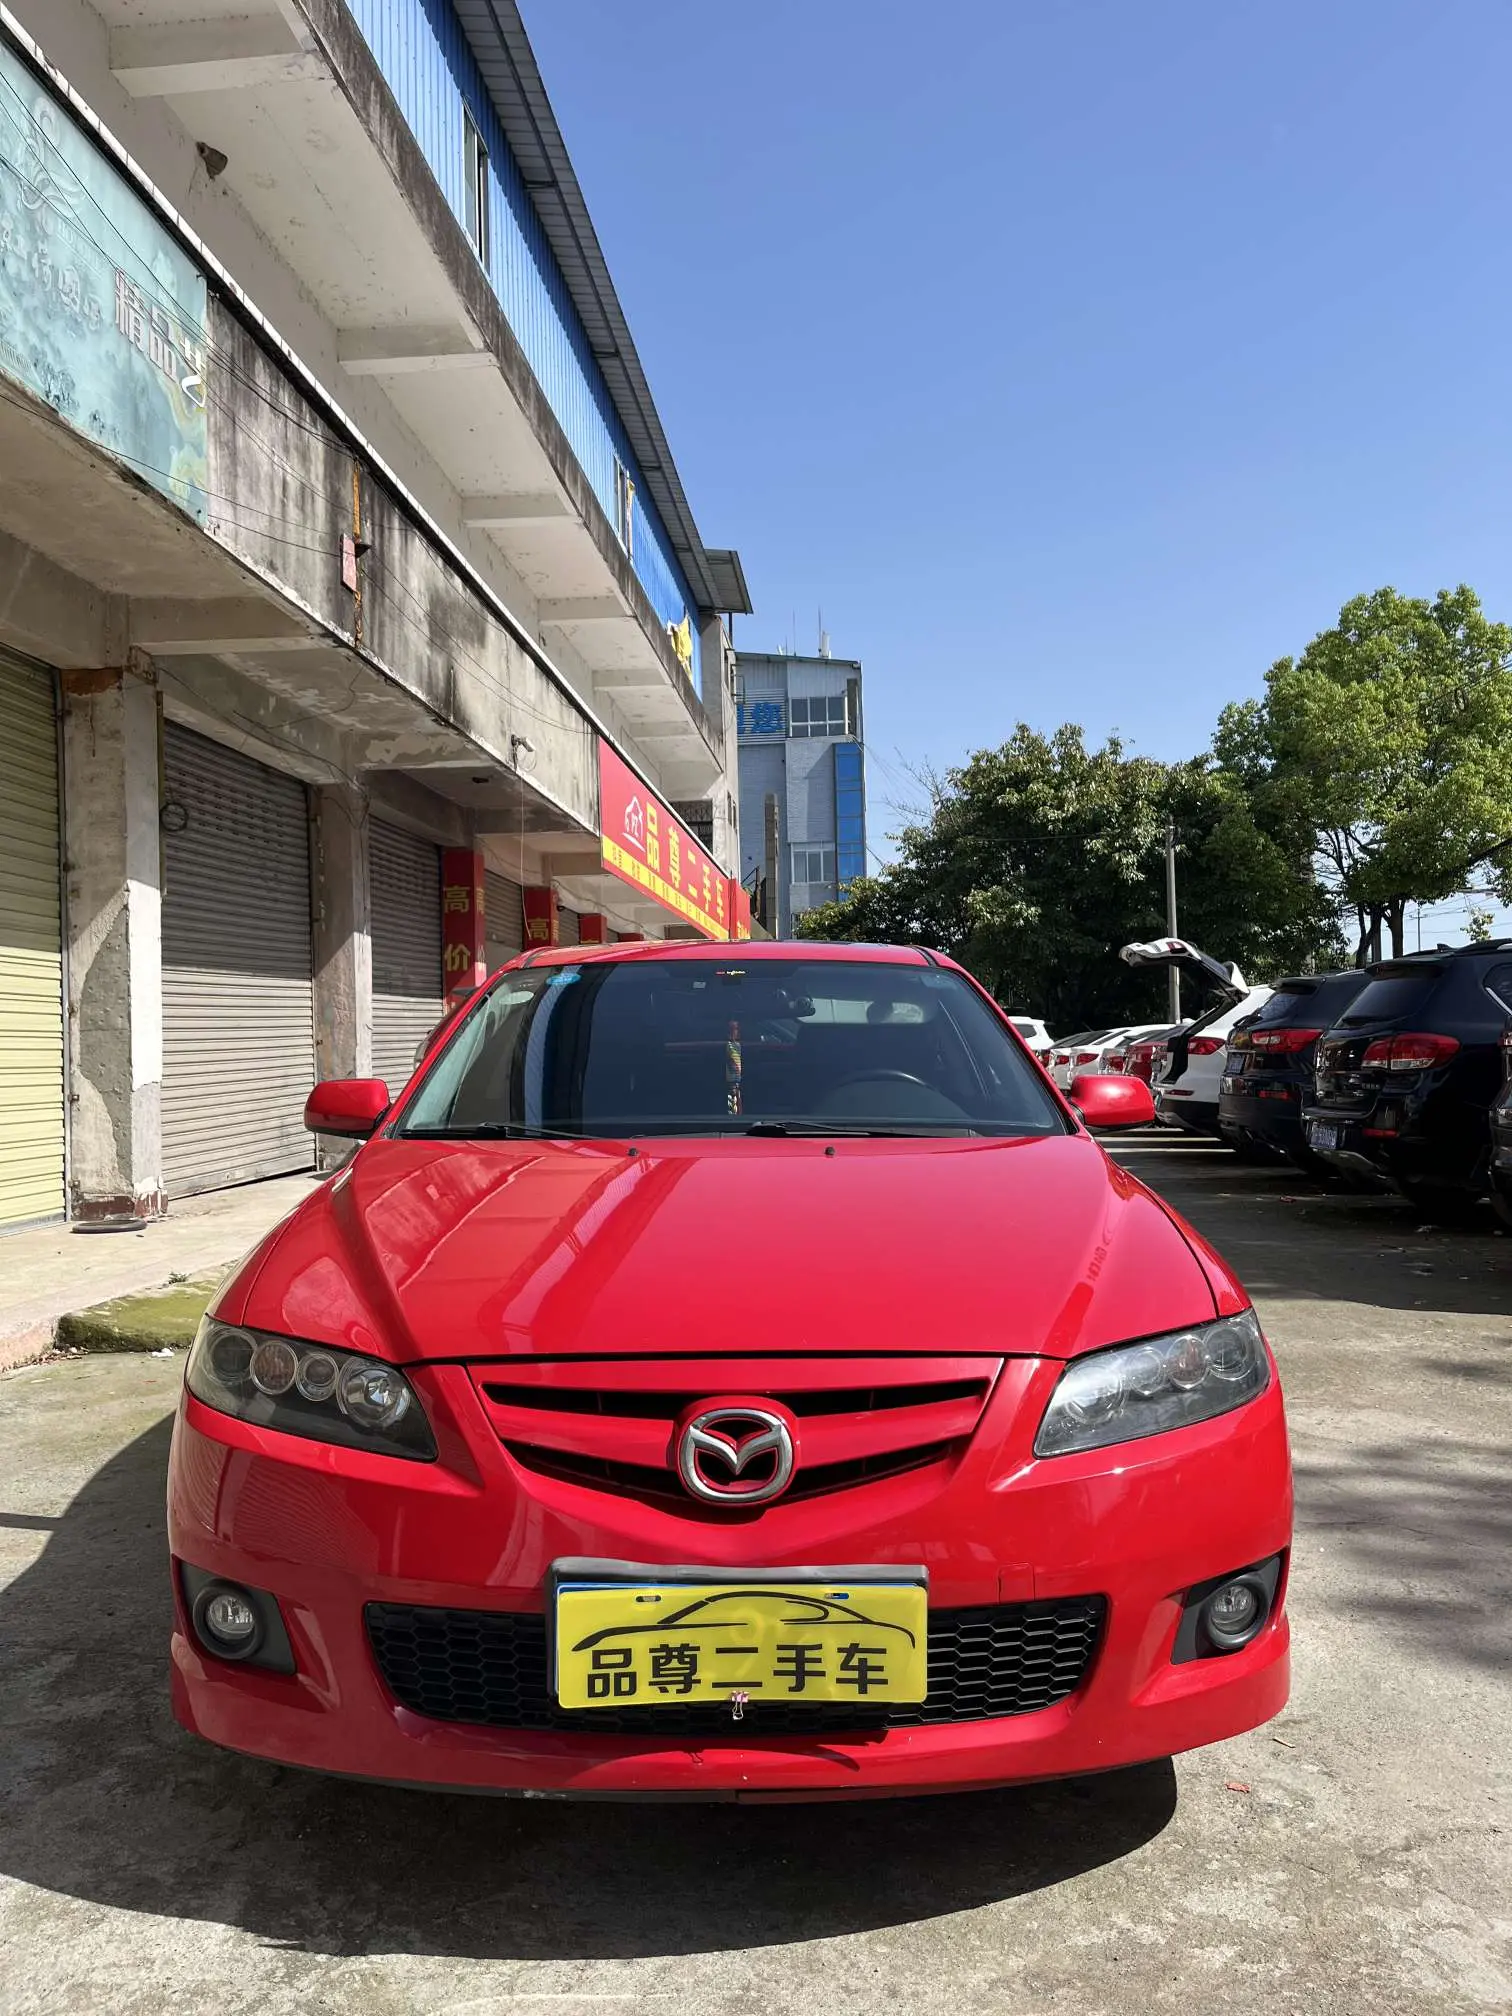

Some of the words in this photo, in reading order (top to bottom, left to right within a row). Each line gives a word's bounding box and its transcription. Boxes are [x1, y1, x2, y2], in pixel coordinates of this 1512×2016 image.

[646, 801, 725, 923] 品尊二手车
[444, 885, 471, 972] 高价
[587, 1643, 889, 1698] 品尊二手车
